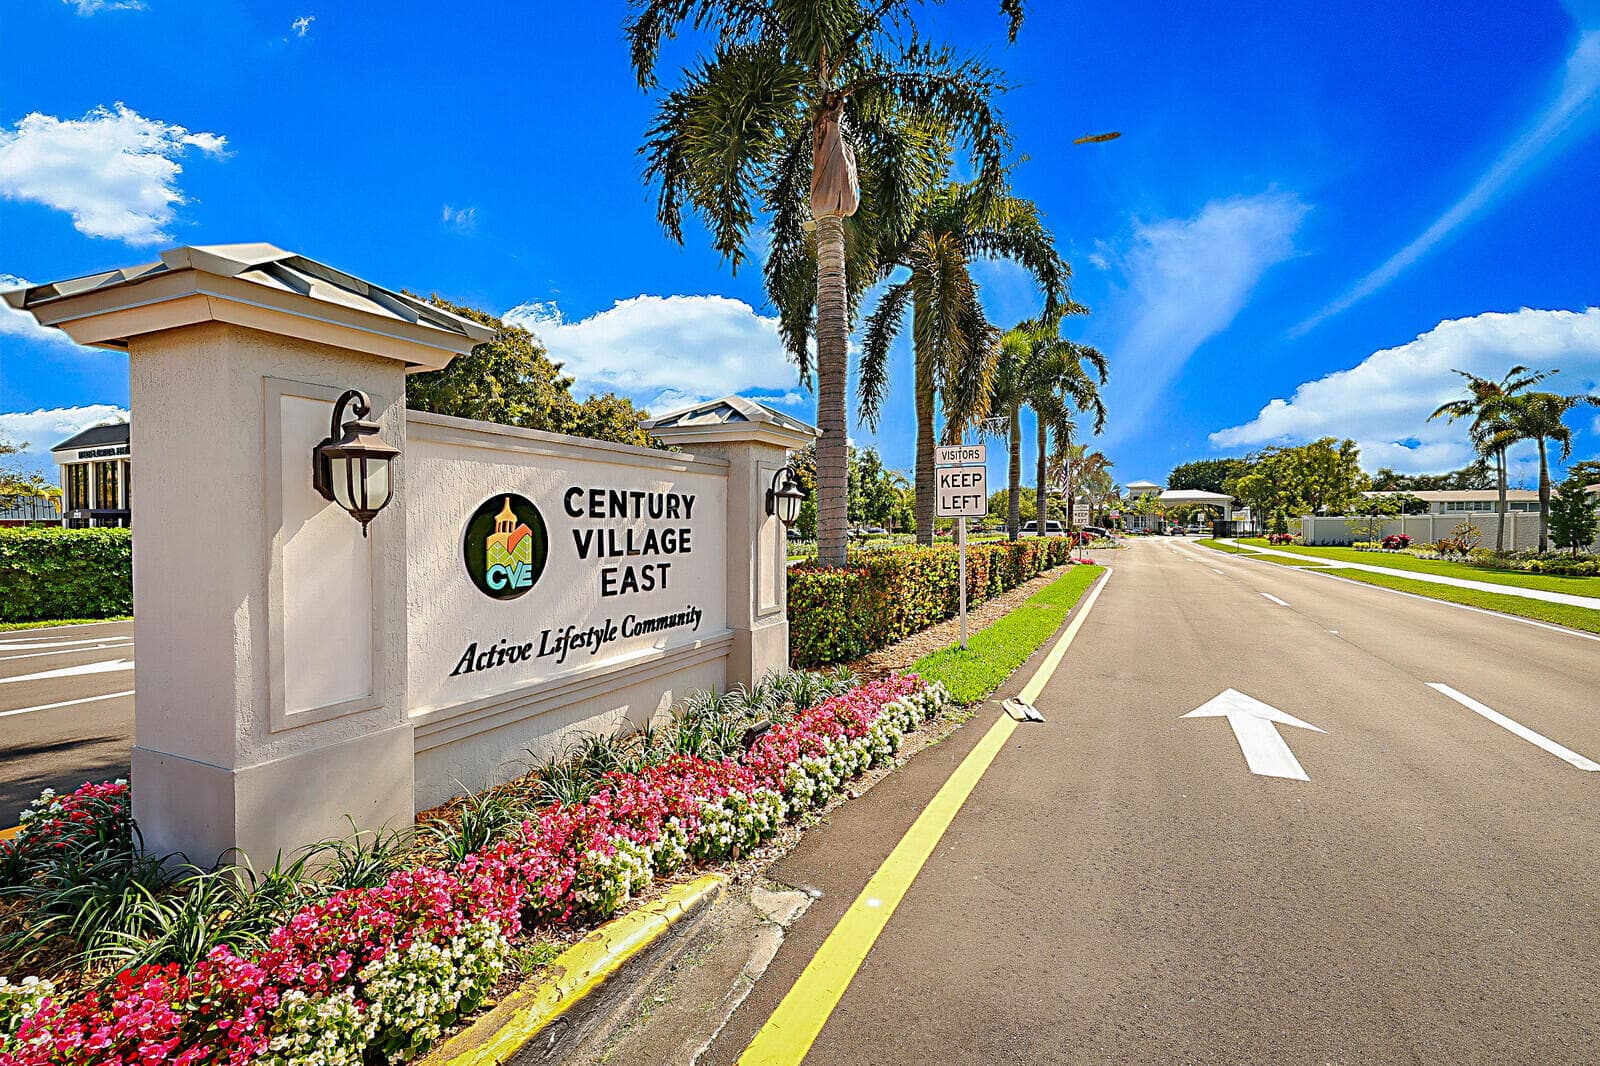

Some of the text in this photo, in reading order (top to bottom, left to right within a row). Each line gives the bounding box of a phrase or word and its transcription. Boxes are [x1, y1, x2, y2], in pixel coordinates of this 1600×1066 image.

[941, 449, 980, 461] VISITORS
[940, 473, 982, 488] KEEP
[563, 486, 696, 520] CENTURY
[942, 494, 981, 510] LEFT
[572, 527, 692, 559] VILLAGE
[485, 561, 533, 590] CVE
[601, 562, 672, 597] EAST
[449, 604, 702, 677] Active Lifestyle Community
